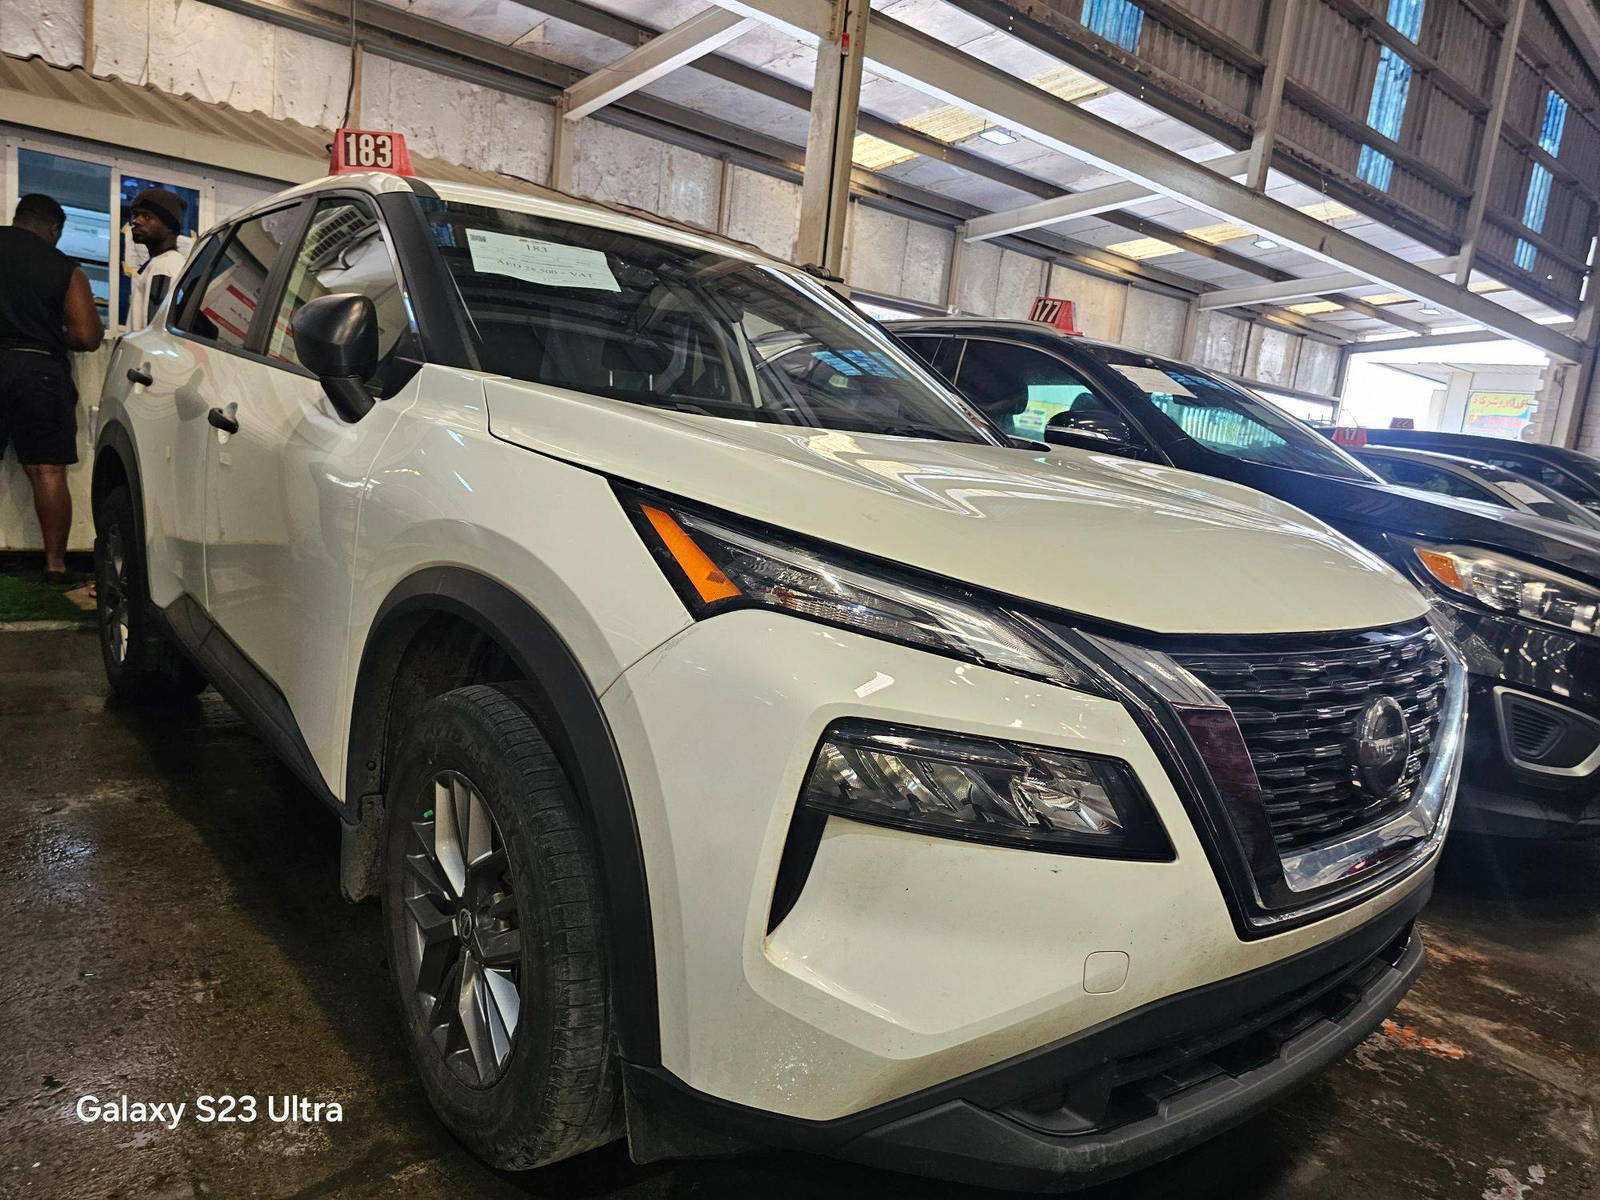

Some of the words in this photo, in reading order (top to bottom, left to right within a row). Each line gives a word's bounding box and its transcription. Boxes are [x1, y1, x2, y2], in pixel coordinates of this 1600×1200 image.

[346, 134, 392, 168] 183
[526, 244, 548, 253] 183
[1033, 300, 1061, 322] 177
